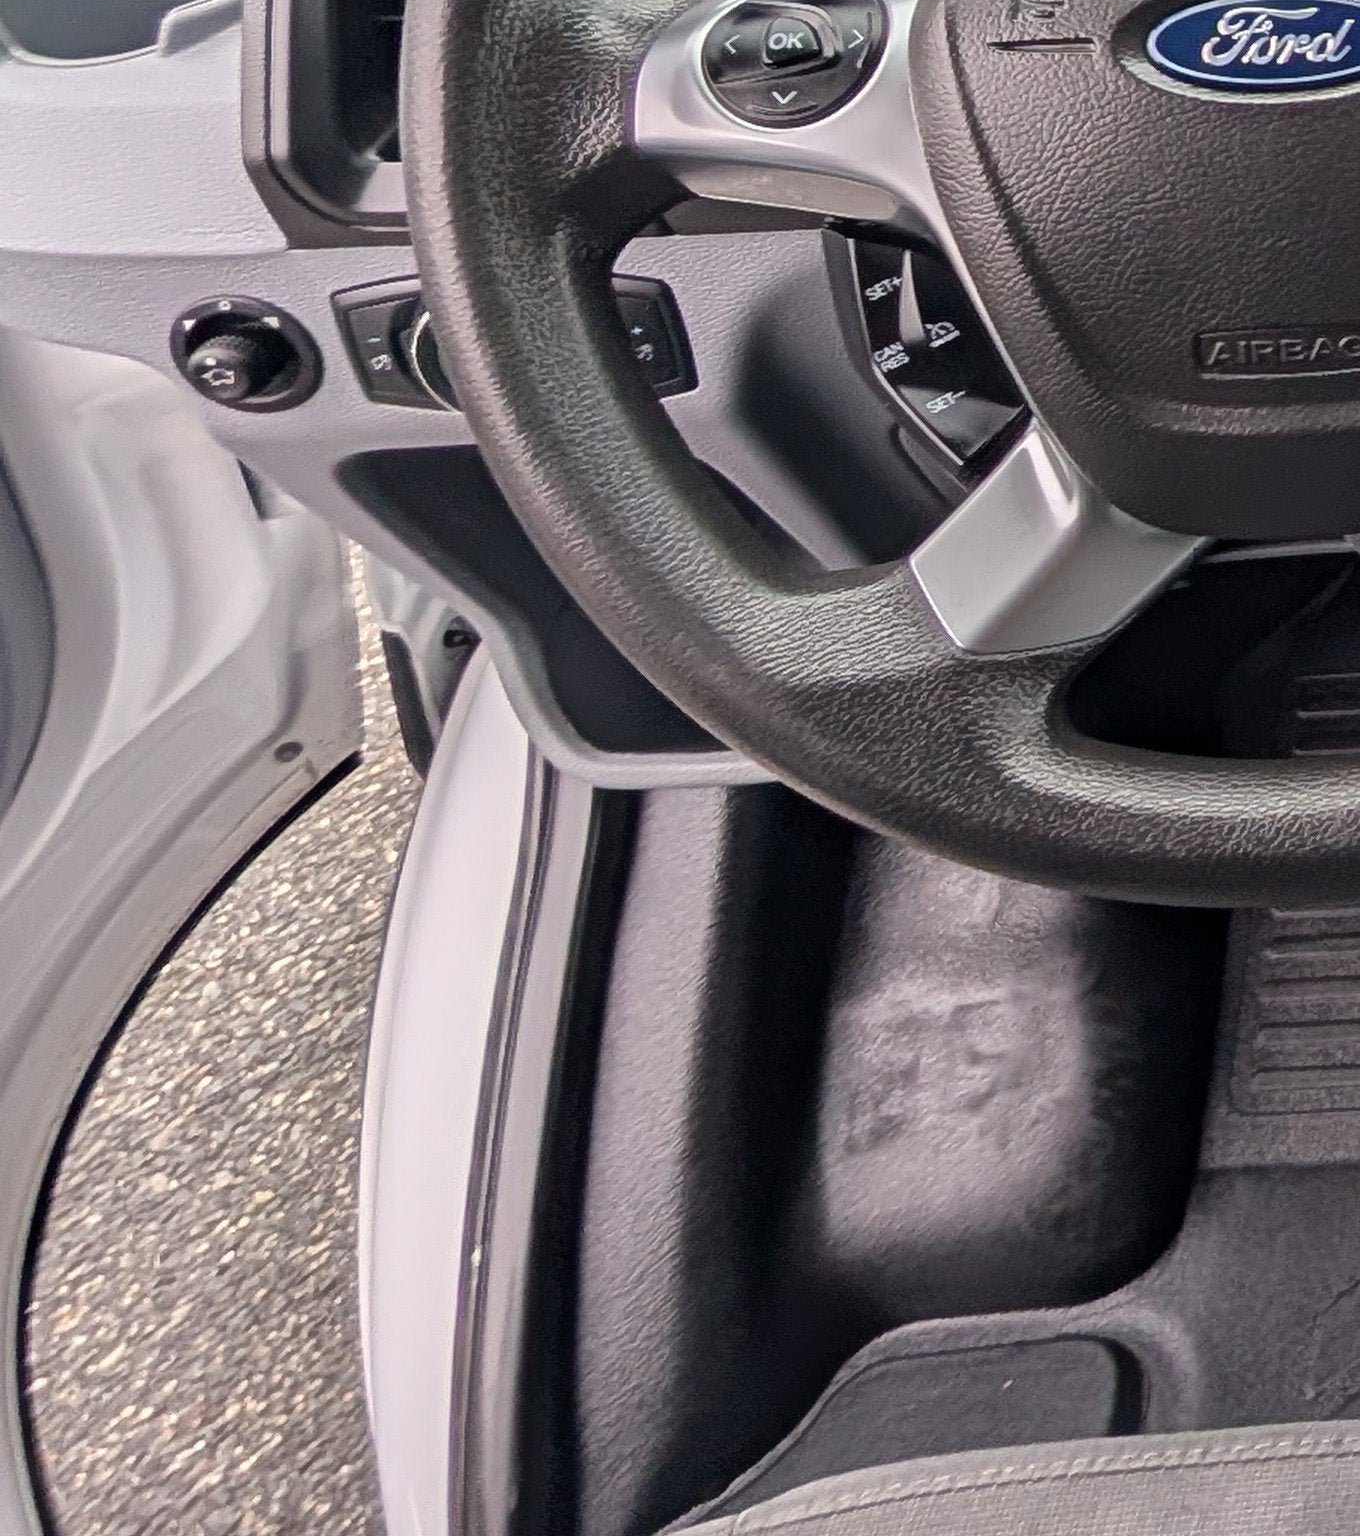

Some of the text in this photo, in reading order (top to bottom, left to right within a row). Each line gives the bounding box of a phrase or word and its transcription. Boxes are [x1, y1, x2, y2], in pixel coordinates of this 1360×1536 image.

[768, 32, 806, 50] OK
[1201, 7, 1356, 66] Ford
[865, 276, 903, 301] SET+
[873, 341, 905, 363] CAN
[880, 352, 911, 373] RES
